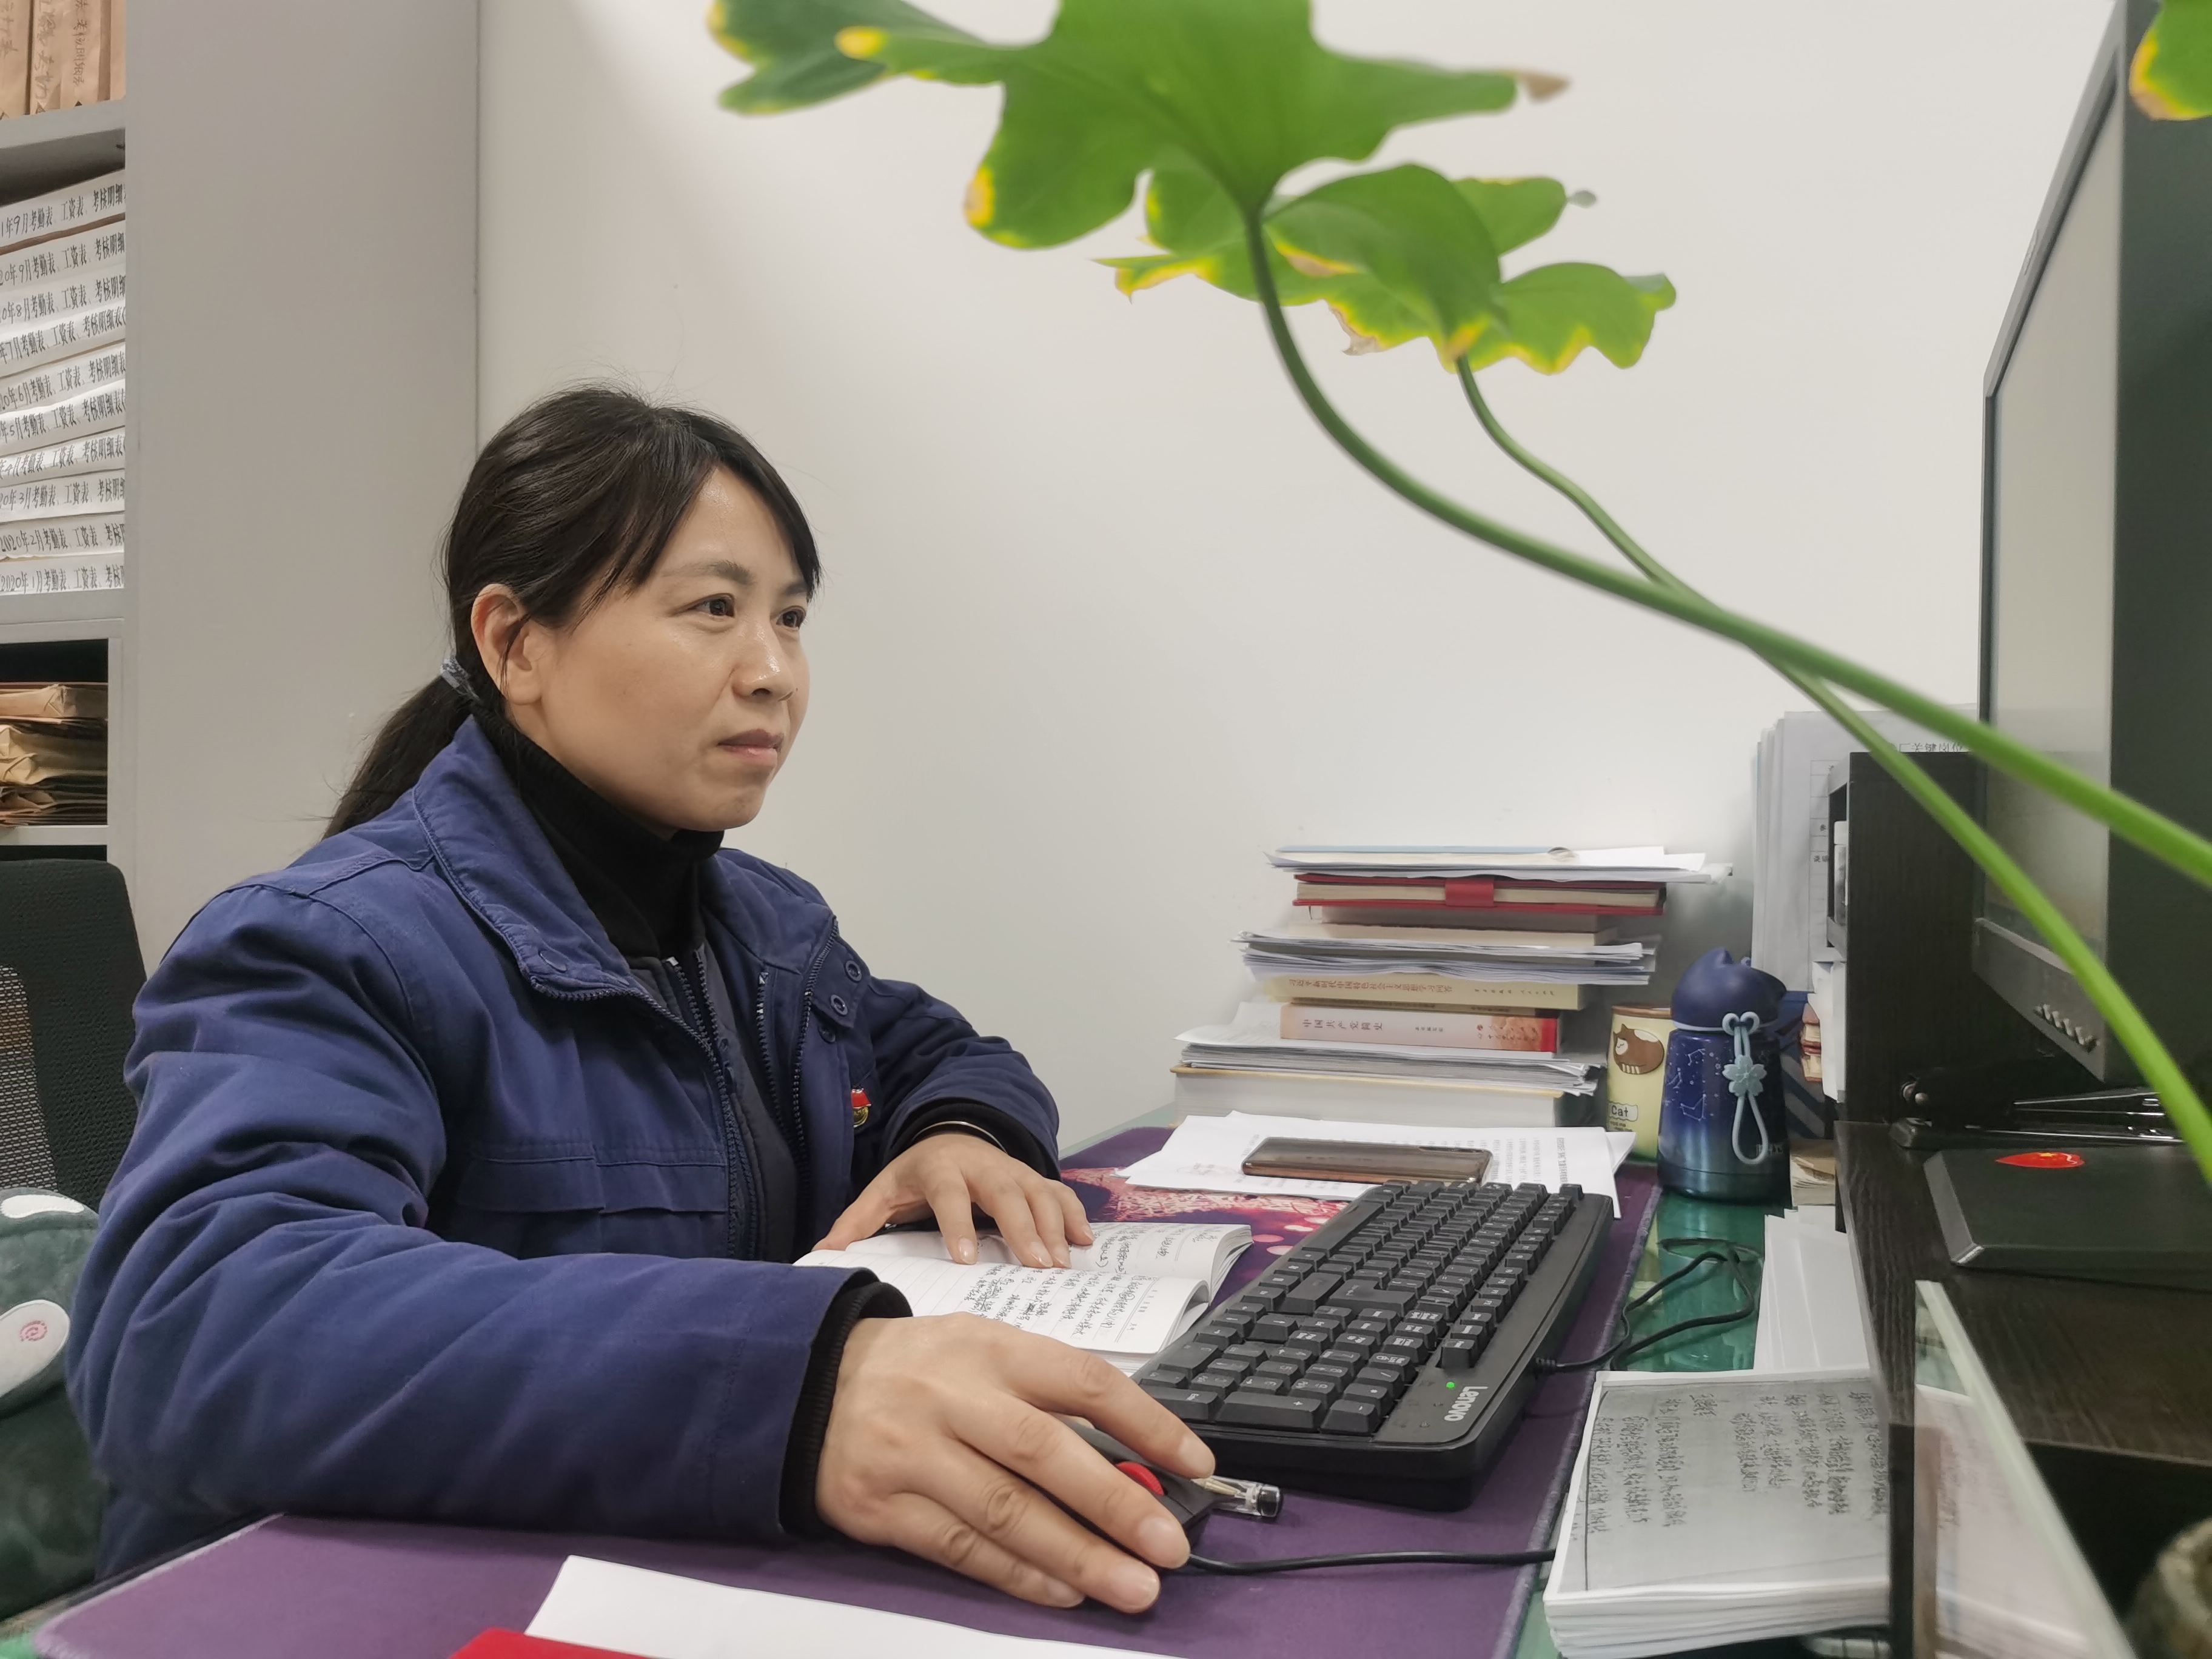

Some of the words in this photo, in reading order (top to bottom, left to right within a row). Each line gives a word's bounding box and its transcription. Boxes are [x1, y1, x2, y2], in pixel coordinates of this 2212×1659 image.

[1302, 1019, 1383, 1031] 中国共产党简史
[1611, 1105, 1629, 1117] Cat
[1444, 1386, 1489, 1421] Lenovo
